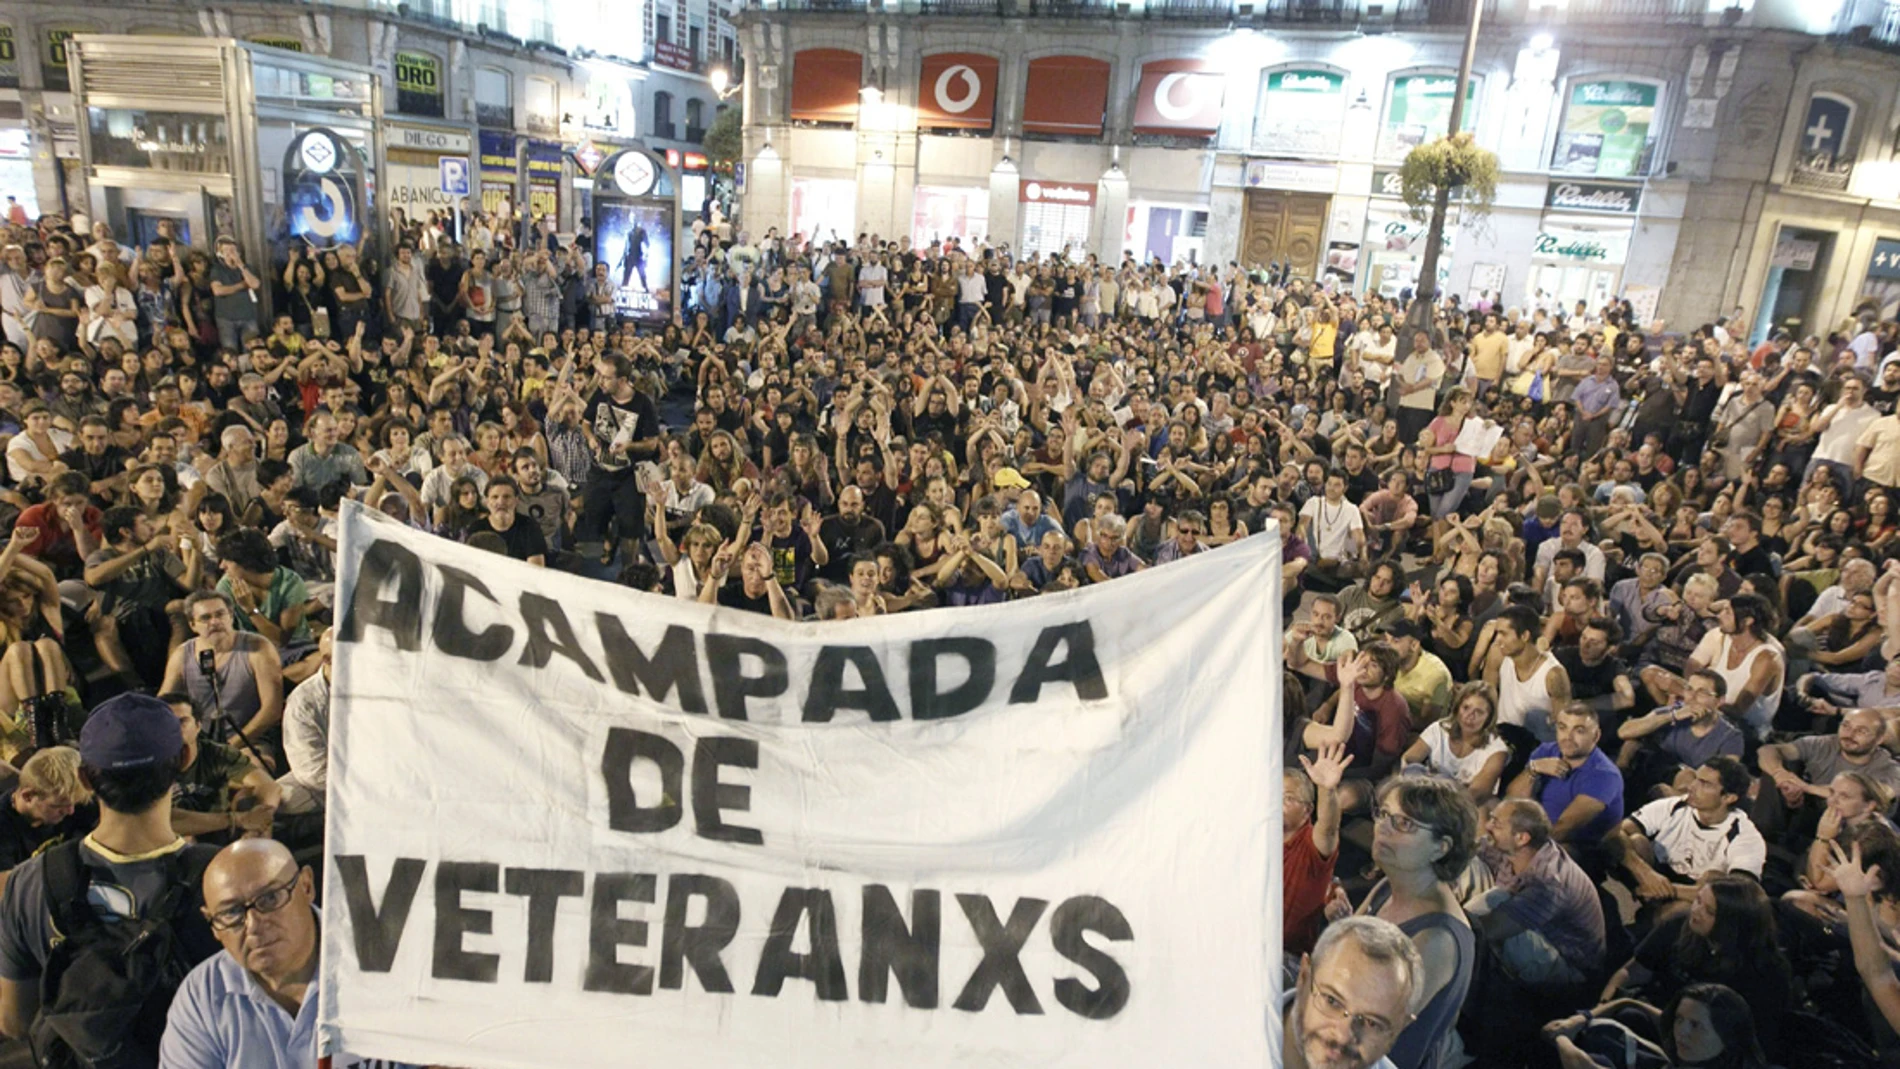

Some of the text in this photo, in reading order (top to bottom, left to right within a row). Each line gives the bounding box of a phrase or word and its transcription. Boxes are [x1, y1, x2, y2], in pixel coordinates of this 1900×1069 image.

[396, 64, 436, 87] ORO
[404, 130, 448, 147] DIEGO
[445, 161, 462, 191] P
[336, 537, 1108, 723] ACAMPADA
[602, 726, 765, 845] DE
[334, 854, 1135, 1020] VETERANXS
